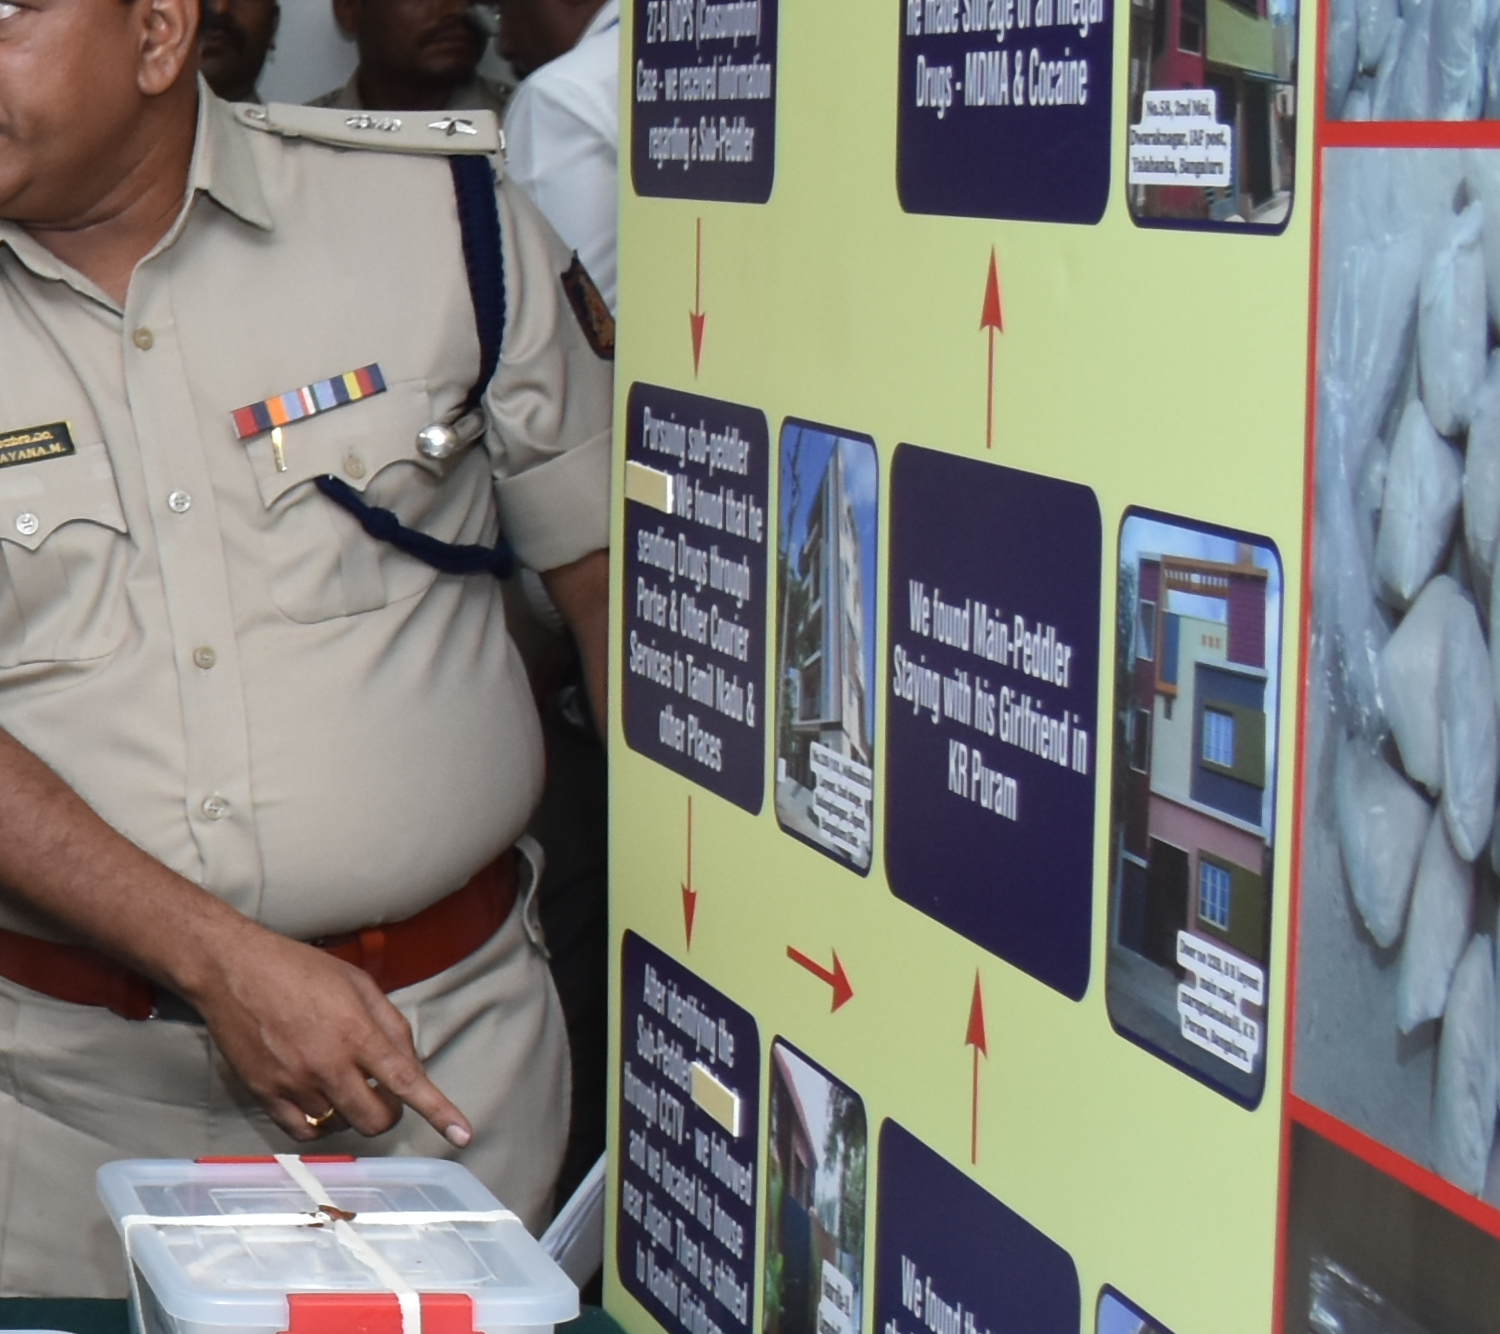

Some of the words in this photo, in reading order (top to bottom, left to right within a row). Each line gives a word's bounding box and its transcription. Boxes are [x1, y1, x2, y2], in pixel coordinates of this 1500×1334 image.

[916, 55, 953, 120] Drugs
[965, 51, 1009, 107] MDMA
[1013, 49, 1025, 106] &
[1028, 47, 1088, 106] Cocaine
[643, 406, 685, 468] Pursuing
[688, 420, 749, 476] sub-peddler
[676, 473, 693, 519] We
[695, 480, 724, 529] found
[726, 488, 746, 537] that
[749, 495, 762, 543] he
[638, 526, 675, 582] sending
[678, 533, 707, 592] Drugs
[710, 545, 750, 608] through
[637, 577, 667, 627] Porter
[670, 590, 678, 632] &
[681, 592, 708, 644] Other
[711, 605, 749, 661] Courier
[909, 579, 929, 636] We
[932, 588, 970, 651] found
[973, 601, 1072, 688] Main-Peddler
[630, 630, 671, 688] Services
[674, 651, 684, 693] to
[686, 654, 714, 708] Tamil
[716, 664, 743, 721] Nadu
[746, 682, 755, 727] &
[893, 644, 940, 724] Staying
[944, 668, 972, 726] with
[975, 677, 995, 737] his
[999, 685, 1069, 768] Girlfriend
[1072, 715, 1088, 775] in
[659, 705, 685, 752] other
[688, 714, 722, 772] Places
[949, 739, 968, 798] KR
[971, 749, 1018, 822] Puram
[902, 1255, 923, 1313] We
